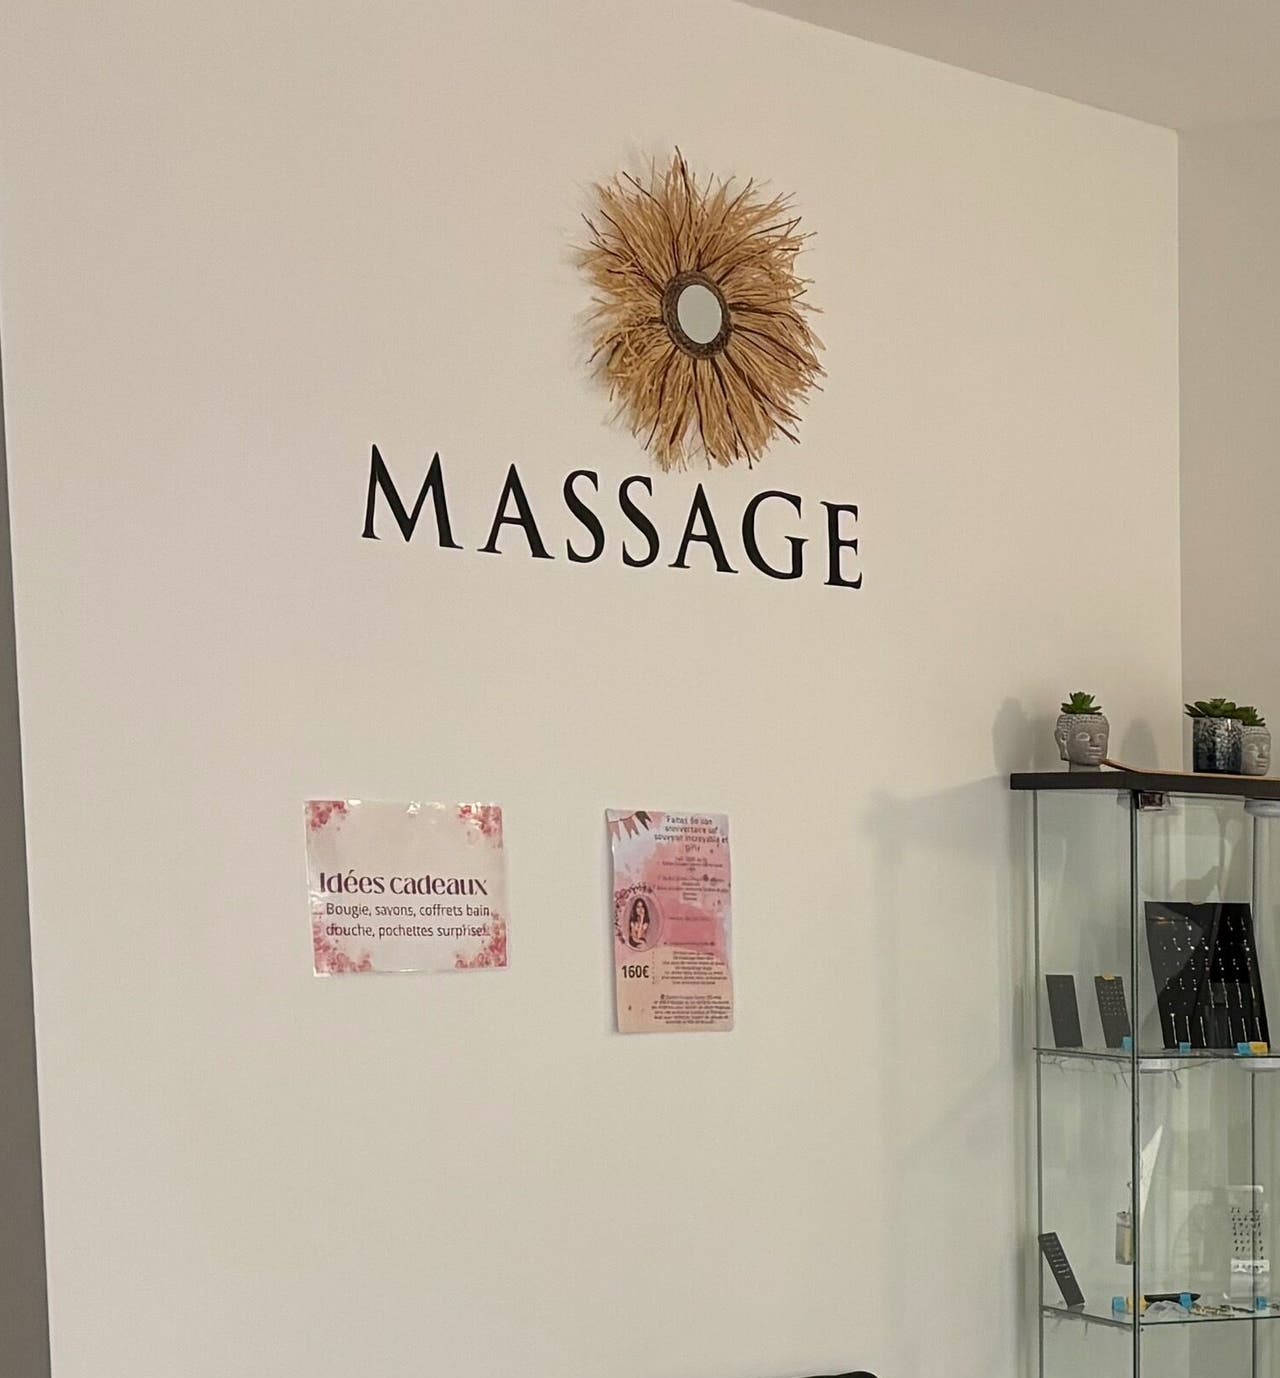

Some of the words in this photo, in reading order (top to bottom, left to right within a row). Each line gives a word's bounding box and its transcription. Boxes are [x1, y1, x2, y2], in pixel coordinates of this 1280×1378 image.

[361, 443, 863, 590] MASSAGE
[319, 869, 385, 895] Idées
[389, 874, 488, 896] cadeaux
[326, 902, 372, 919] Bougie,
[375, 904, 417, 918] savons,
[419, 903, 463, 917] coffrets
[326, 923, 375, 938] douche,
[378, 924, 433, 940] pochettes
[621, 964, 650, 980] 160€
